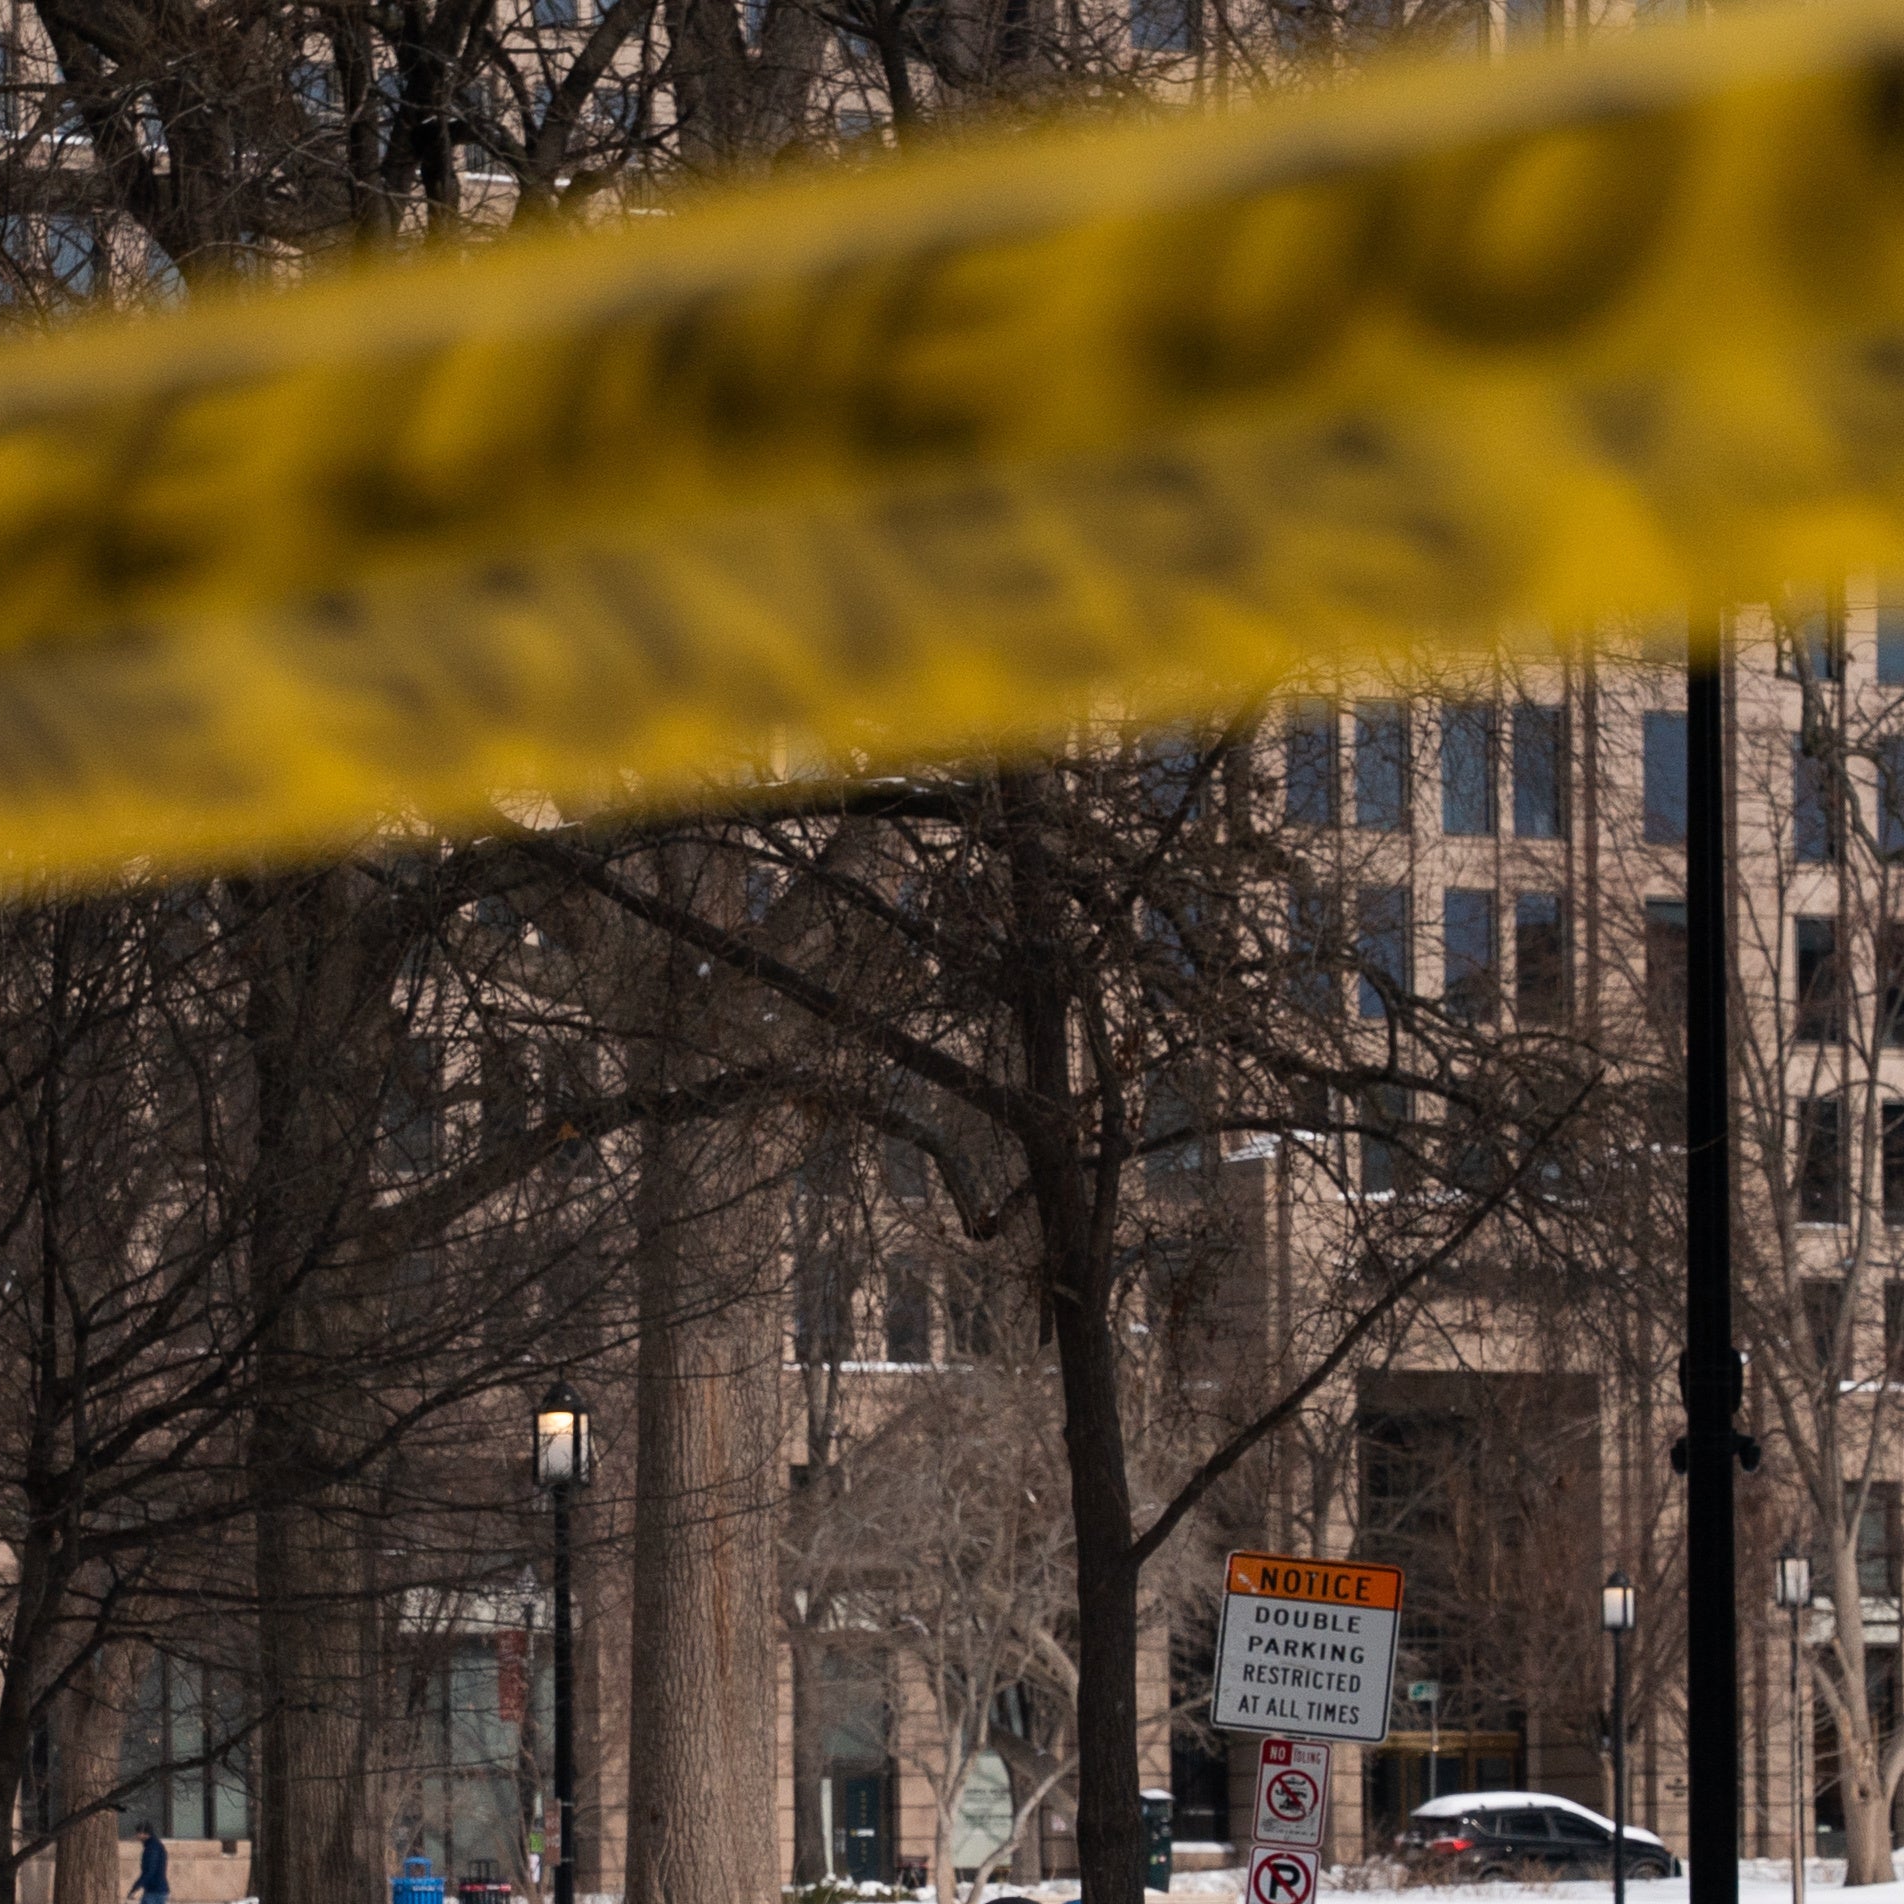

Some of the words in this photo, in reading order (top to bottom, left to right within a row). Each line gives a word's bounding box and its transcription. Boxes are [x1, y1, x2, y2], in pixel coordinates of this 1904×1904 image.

[1260, 1567, 1371, 1602] NOTICE
[1255, 1606, 1361, 1634] DOUBLE
[1248, 1635, 1365, 1665] PARKING
[1243, 1663, 1361, 1693] RESTRICTED
[1238, 1695, 1260, 1713] AT
[1266, 1697, 1301, 1720] ALL
[1307, 1701, 1360, 1725] TIMES
[1269, 1744, 1286, 1761] NO
